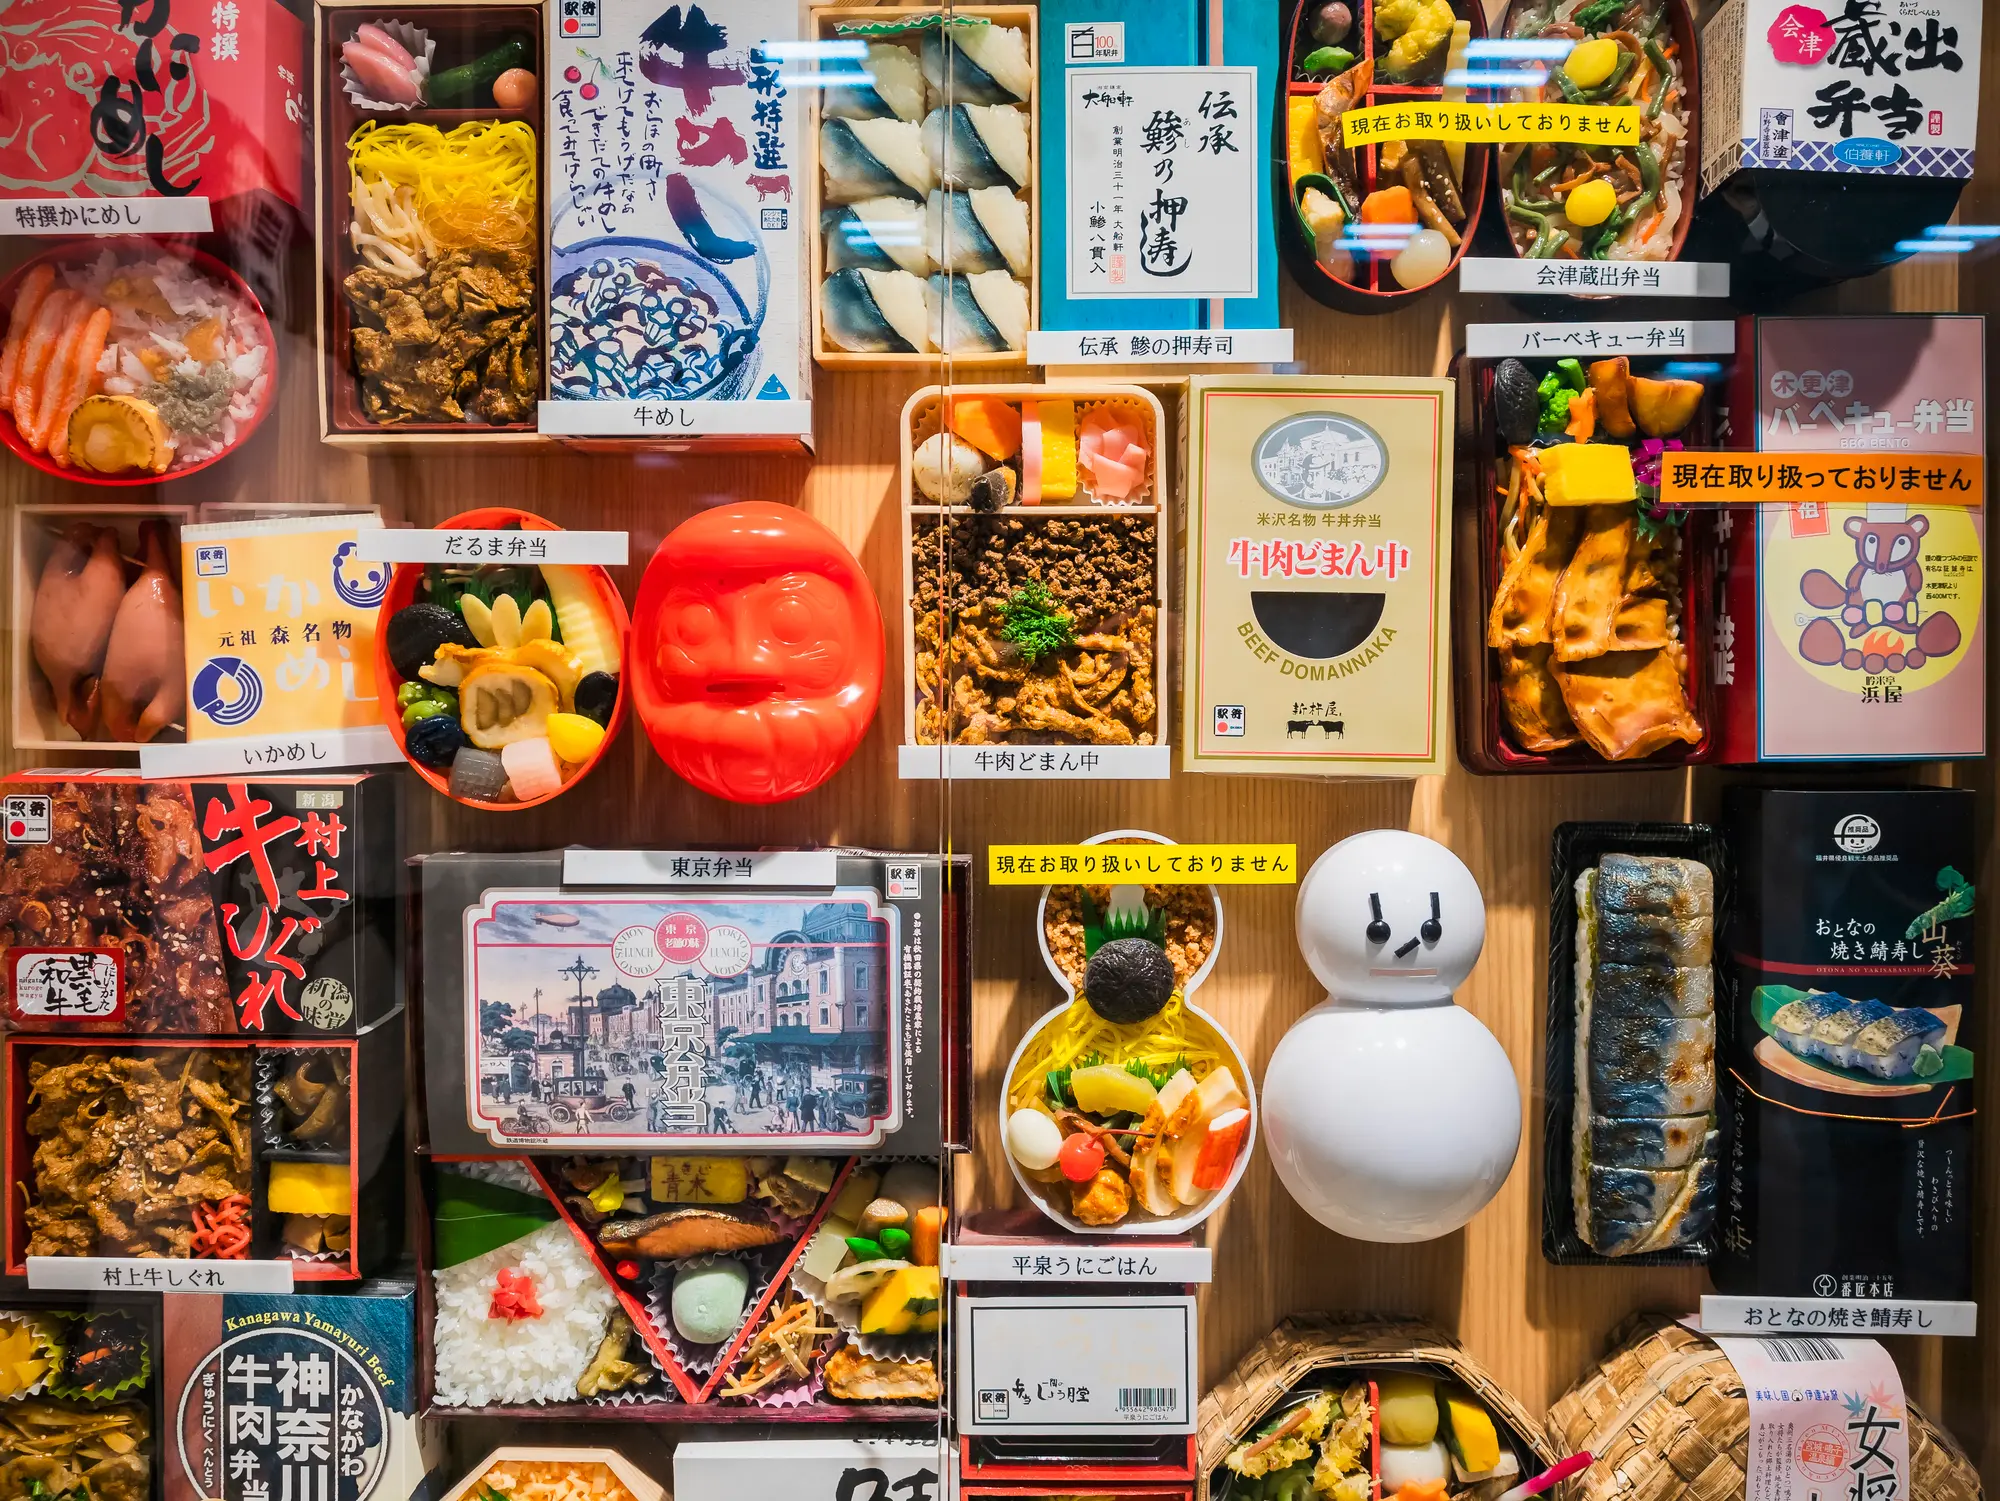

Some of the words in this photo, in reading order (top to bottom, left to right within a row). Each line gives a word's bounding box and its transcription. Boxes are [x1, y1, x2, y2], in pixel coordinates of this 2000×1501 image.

[1898, 8, 1941, 16] くらだしべんとう
[211, 1, 240, 62] 特撰
[1095, 36, 1114, 48] 100
[1778, 13, 1823, 59] 会津
[1820, 0, 1963, 77] 蔵出
[1082, 89, 1134, 109] 大船軒
[1806, 80, 1924, 140] 弁当
[638, 3, 757, 265] 牛めし
[1197, 91, 1240, 155] 伝承
[1350, 111, 1632, 136] 現在お取り扱いしておりません
[1844, 148, 1890, 161] 伯養軒
[15, 205, 141, 228] 特撰かにめし
[1089, 201, 1107, 274] 小鯵八貫入
[1537, 264, 1660, 288] 会津蔵出弁当
[1078, 336, 1118, 356] 伝承
[1130, 335, 1233, 356] 鯵の押寿司
[1522, 327, 1686, 349] バーベキュー弁当
[1773, 373, 1852, 396] 木更津
[633, 406, 695, 427] 牛めし
[1768, 398, 1974, 436] バーベキュー弁当
[1672, 463, 1972, 491] 現在取り扱っておりません
[1256, 512, 1317, 527] 米沢名物
[1321, 513, 1382, 528] 牛丼弁当
[445, 535, 547, 558] だるま弁当
[1229, 539, 1409, 579] 牛肉どまん中
[196, 574, 322, 619] いか
[218, 629, 257, 648] 元祖
[270, 620, 352, 645] 森名物
[1237, 621, 1280, 665] BEEF
[1280, 625, 1397, 682] DOMANNAKA
[1861, 686, 1902, 704] 浜屋
[243, 742, 327, 765] いかめし
[974, 751, 1099, 772] 牛肉どまん中
[294, 811, 349, 900] 村上
[997, 855, 1289, 874] 現在お取り扱いしておりません
[670, 857, 753, 879] 東京弁当
[203, 783, 321, 1031] 牛しぐれ
[665, 923, 697, 935] 東京
[1815, 918, 1876, 938] おとなの
[624, 947, 653, 957] LUNCH
[710, 947, 740, 957] LUNCH
[1830, 940, 1924, 962] 焼き鯖寿し
[655, 976, 709, 1127] 東京弁当
[103, 1266, 225, 1288] 村上牛しぐれ
[1012, 1255, 1157, 1276] 平泉うにごはん
[1841, 1282, 1893, 1297] 番匠本店
[1744, 1306, 1933, 1329] おとなの焼き鯖寿し
[225, 1311, 300, 1332] Kanagawa
[304, 1312, 369, 1357] Yamayuri
[365, 1353, 395, 1388] Beef
[202, 1372, 216, 1443] ぎゅうにく
[227, 1354, 273, 1501] 牛肉弁当
[276, 1352, 331, 1501] 神奈川
[341, 1384, 365, 1476] かながわ
[203, 1448, 214, 1488] べんとう
